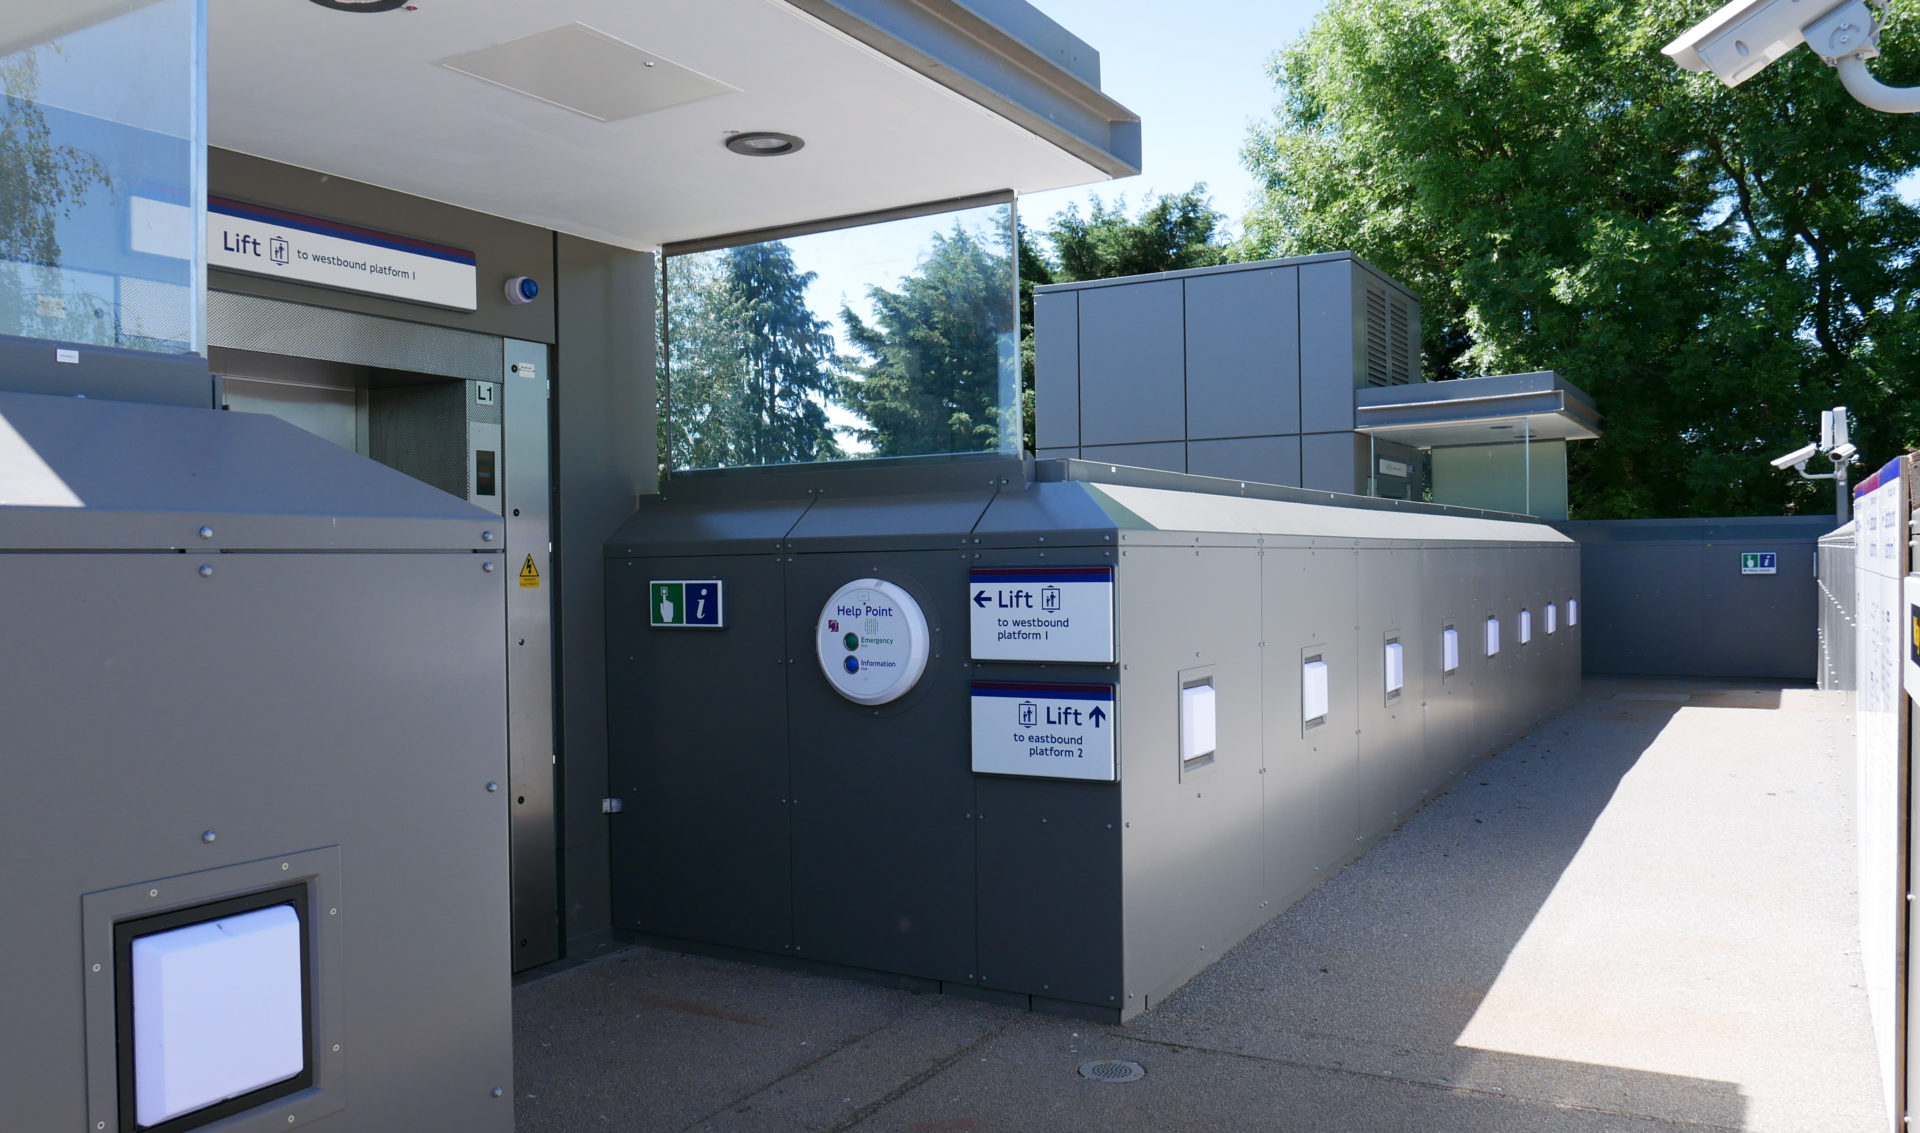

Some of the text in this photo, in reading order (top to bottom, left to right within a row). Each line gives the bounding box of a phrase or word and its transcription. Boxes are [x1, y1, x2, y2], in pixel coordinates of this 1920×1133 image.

[223, 230, 262, 257] Lift
[297, 248, 309, 260] to
[311, 254, 367, 272] westbound
[369, 264, 410, 280] platform
[478, 384, 493, 401] L1
[998, 589, 1033, 609] Lift
[837, 605, 893, 619] Help Point
[997, 617, 1070, 628] to westbound
[860, 636, 894, 645] Emergency
[997, 630, 1042, 642] platform
[860, 660, 896, 668] Information
[1046, 706, 1083, 726] Lift
[1013, 733, 1083, 746] to eastbound
[1029, 746, 1084, 759] platform 2
